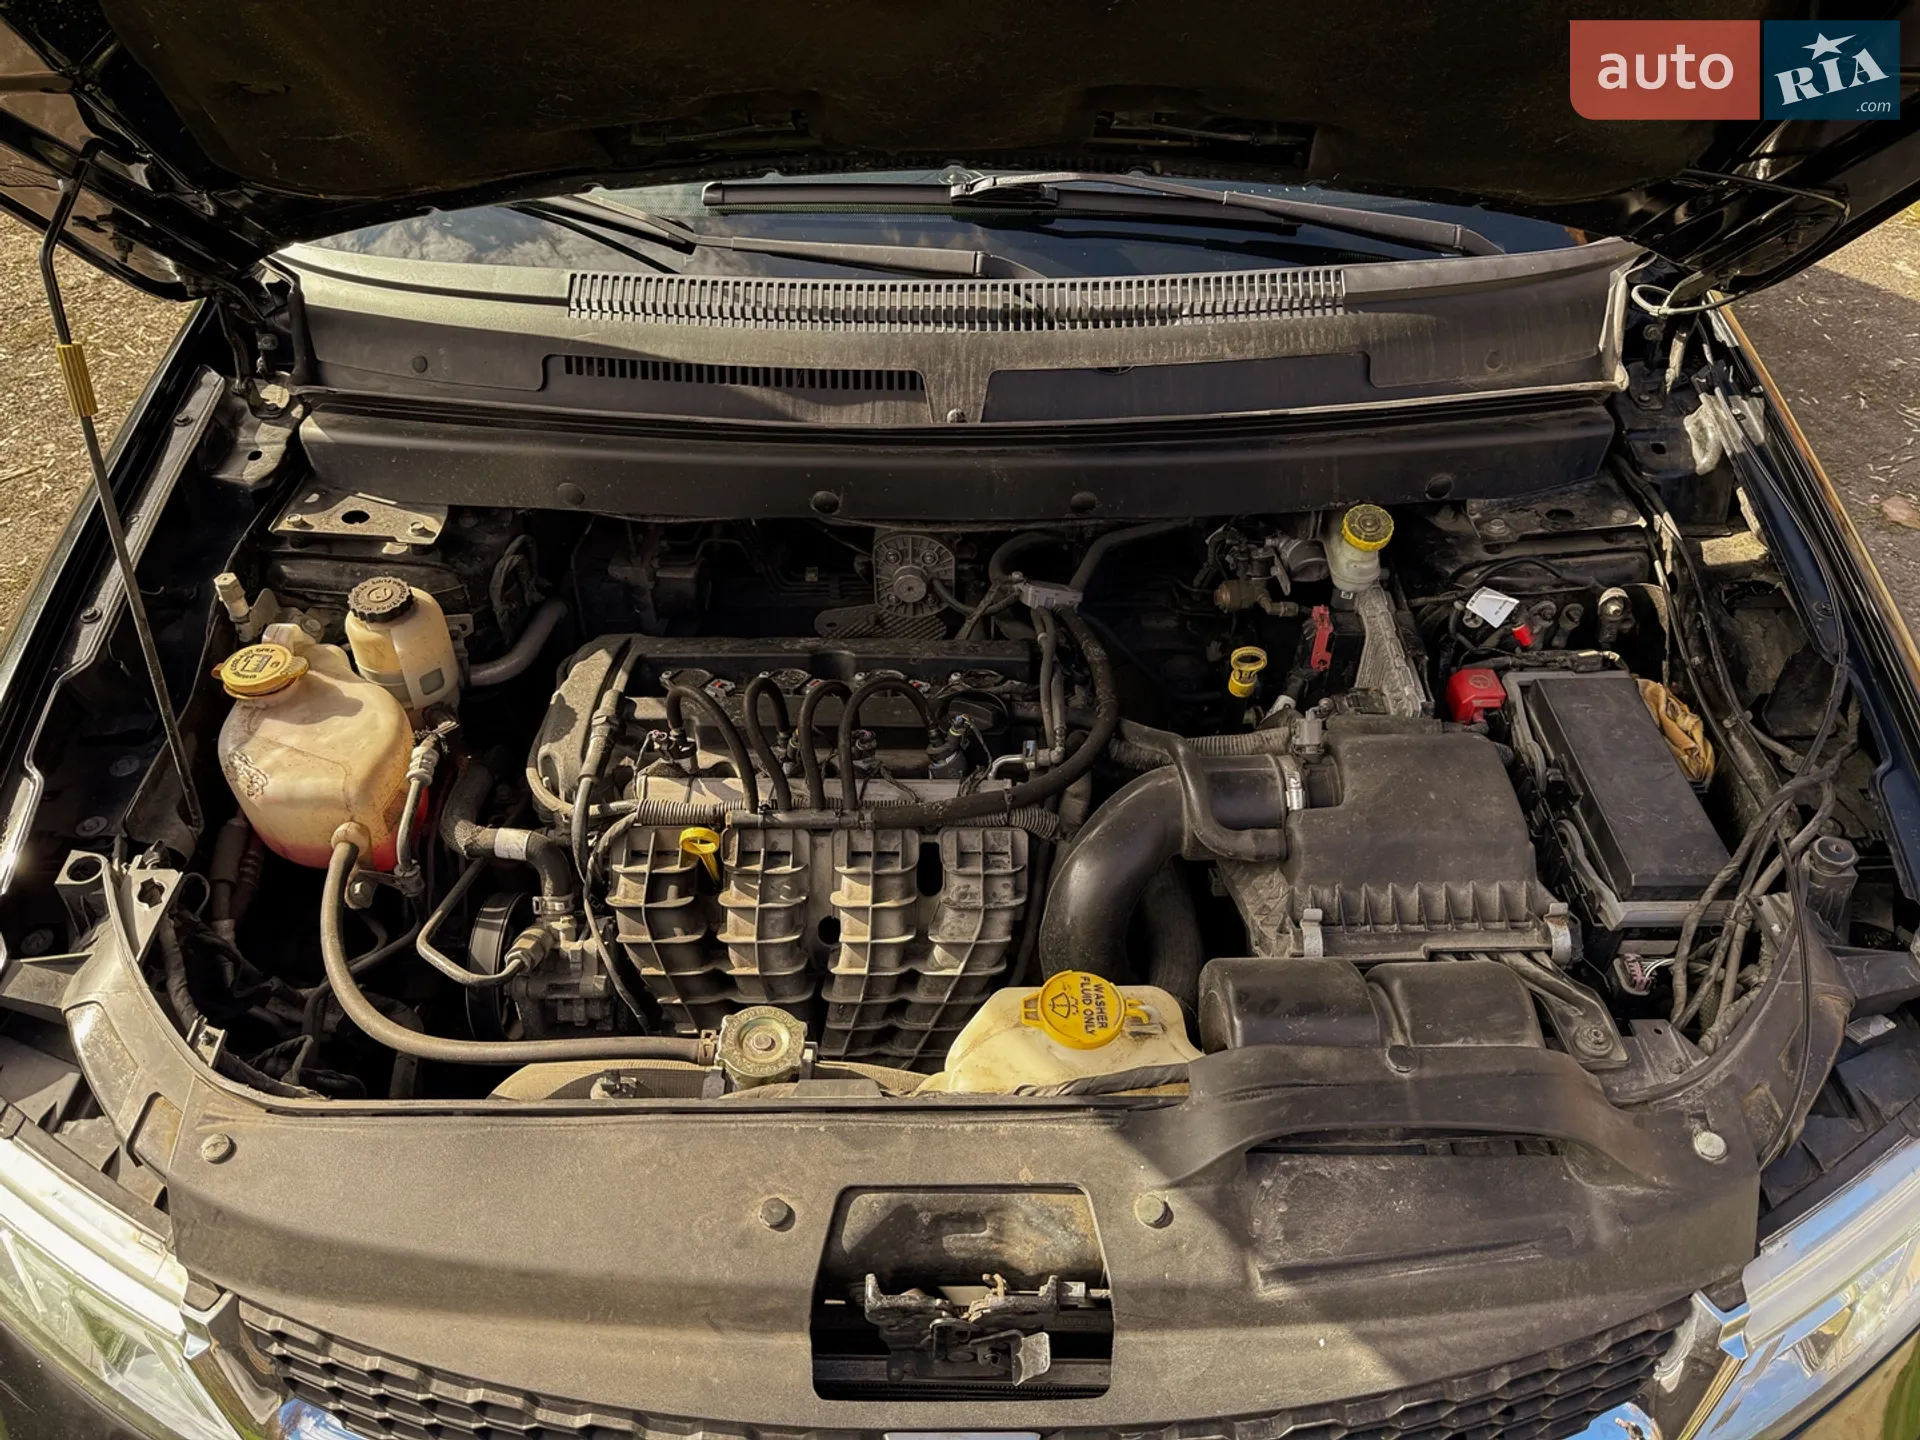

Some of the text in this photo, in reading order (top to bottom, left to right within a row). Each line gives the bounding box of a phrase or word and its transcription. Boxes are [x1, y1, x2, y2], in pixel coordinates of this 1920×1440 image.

[1080, 976, 1096, 1035] FLUID ONLY
[1094, 983, 1108, 1029] WASHER
